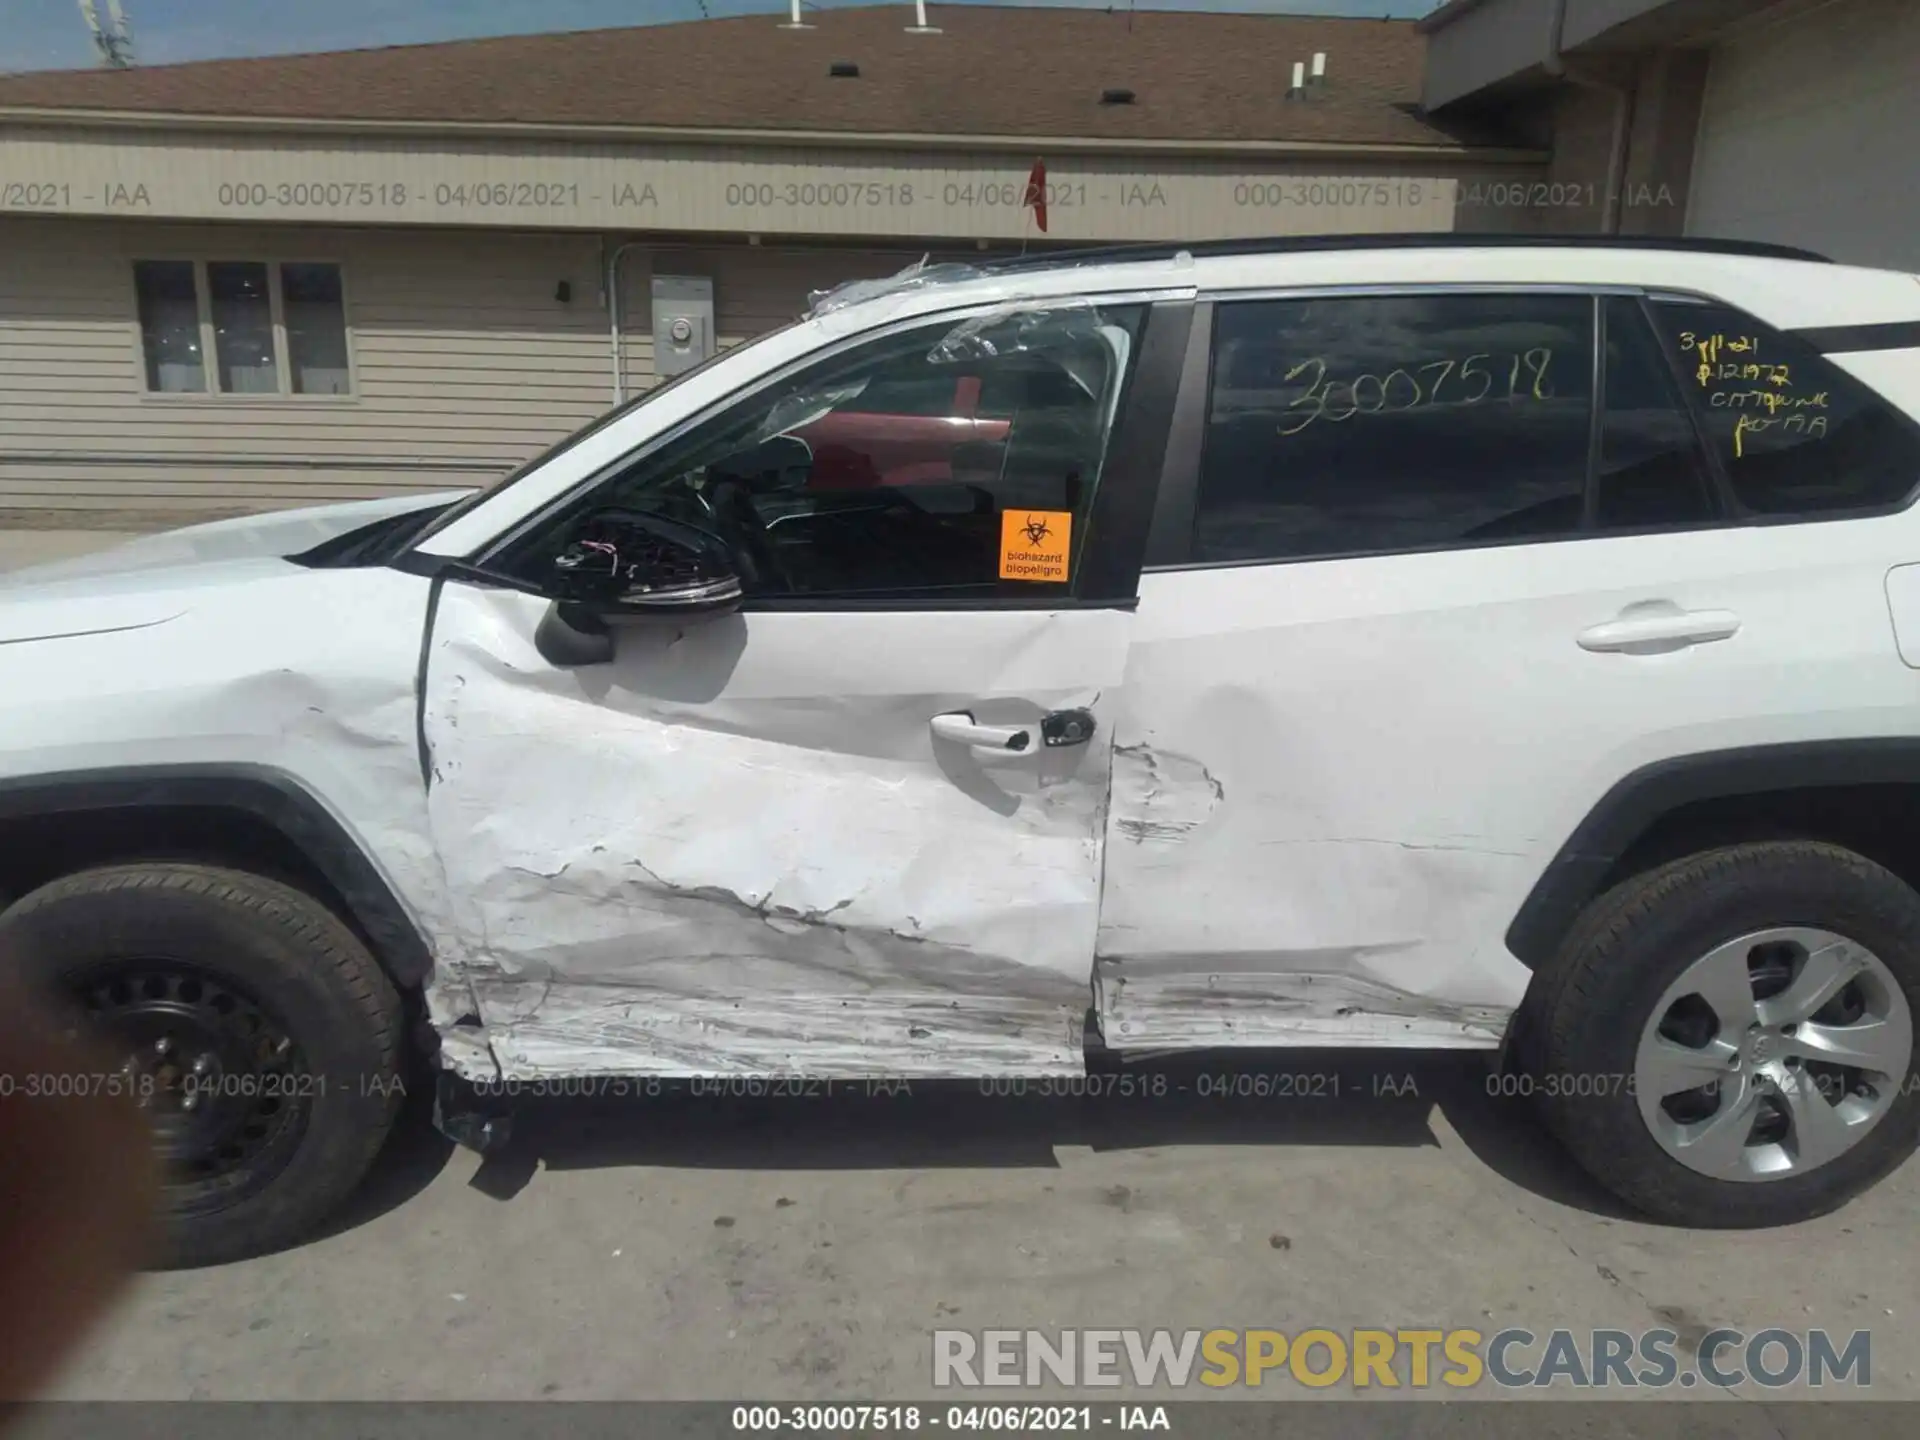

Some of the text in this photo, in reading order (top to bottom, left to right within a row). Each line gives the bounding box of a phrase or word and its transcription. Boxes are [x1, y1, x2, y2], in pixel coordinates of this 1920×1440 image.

[1277, 347, 1554, 435] 30007518
[1007, 552, 1063, 563] biohazard
[1005, 563, 1062, 577] biopeligro
